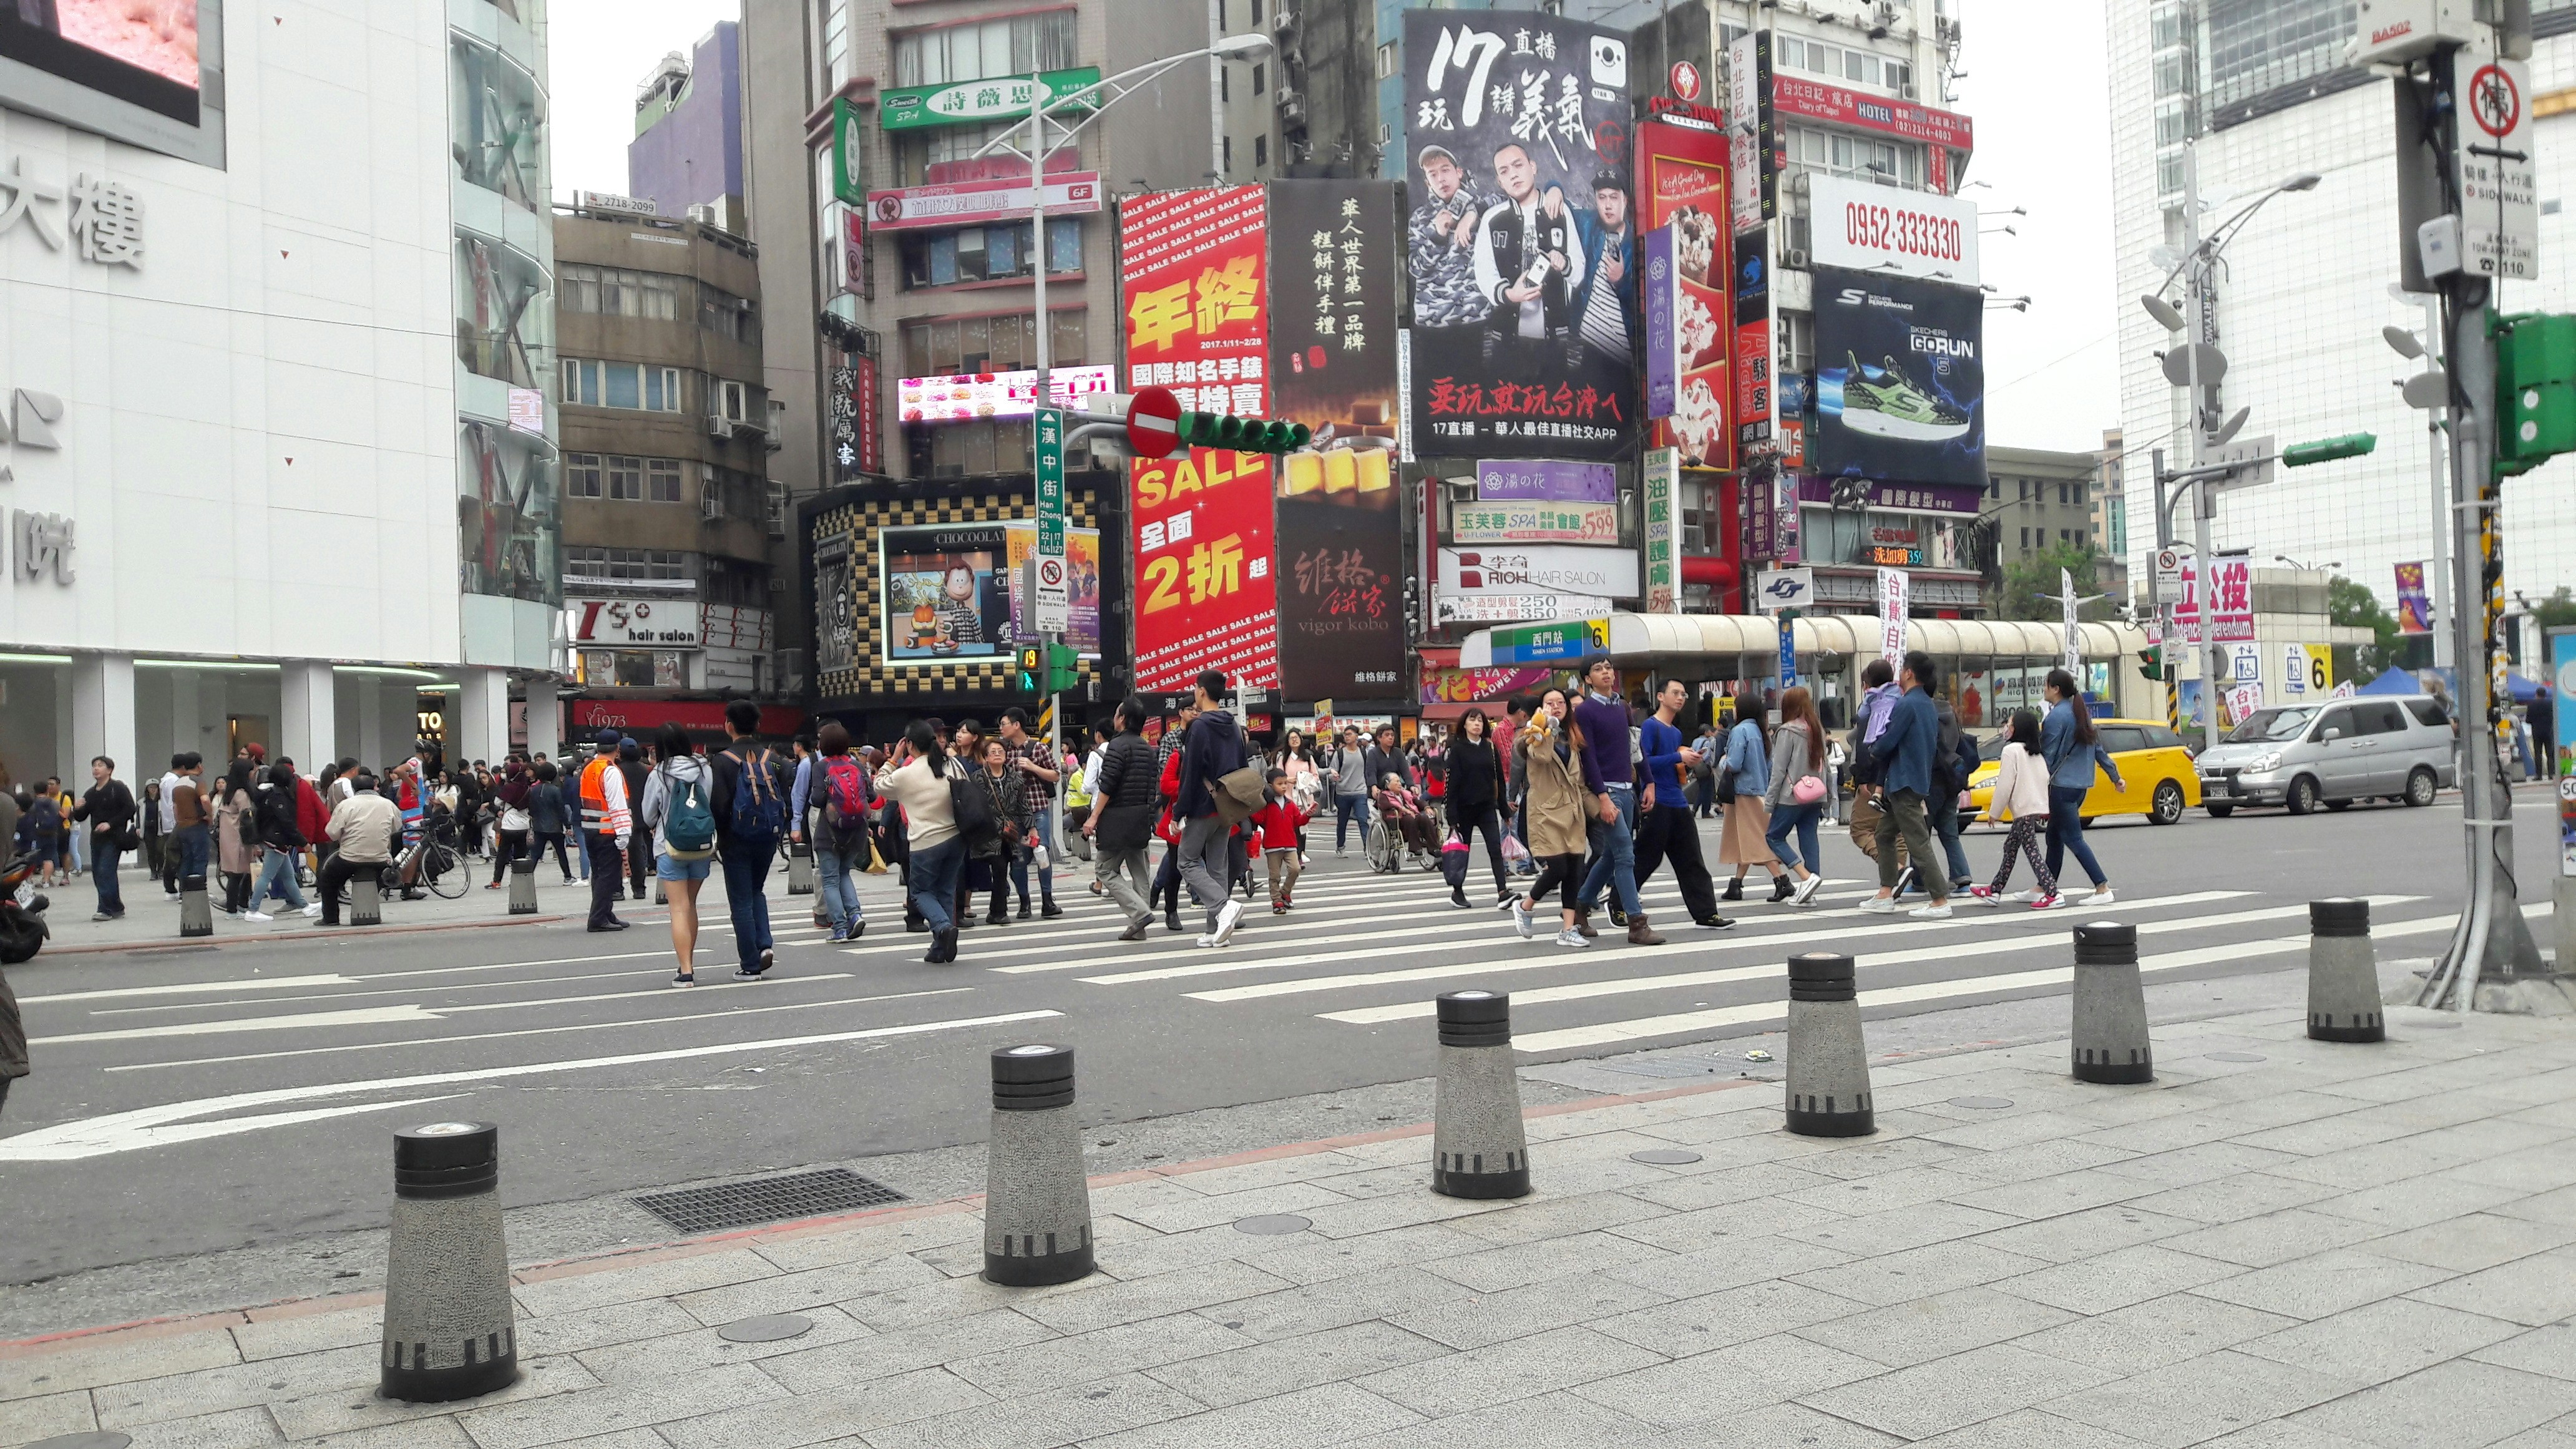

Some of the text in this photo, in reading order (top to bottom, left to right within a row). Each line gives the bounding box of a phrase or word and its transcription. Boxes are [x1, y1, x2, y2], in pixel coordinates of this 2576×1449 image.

[1511, 26, 1558, 61] 直播
[1427, 23, 1507, 127] 17
[1418, 97, 1455, 131] 玩
[1857, 102, 1891, 122] HOTEL
[1072, 189, 1089, 200] 6F
[2479, 190, 2534, 205] SIDWALK
[604, 197, 655, 212] 2718-2099
[1122, 195, 1167, 219] SALE SALE
[1123, 191, 1216, 235] SALE SALE SALE SALE
[1123, 188, 1264, 250] SALE SALE SALE SALE SALE SALE
[1493, 230, 1508, 248] 17
[1340, 197, 1367, 352] 華人世界第一品牌
[2502, 261, 2524, 275] 110
[1128, 254, 1261, 353] 年終
[1652, 285, 1665, 350] 湯の花
[1910, 325, 1948, 336] SKECHERS
[1131, 356, 1262, 388] 國際知名手錶
[1936, 356, 1951, 374] 5
[1433, 421, 1617, 440] 17直播 華人最佳直播社交APP
[1042, 427, 1058, 497] 漢中街
[1137, 449, 1265, 509] SALE
[1505, 472, 1546, 490] 湯の花
[1040, 500, 1054, 509] Han
[1040, 510, 1061, 521] Zhong
[1460, 512, 1506, 530] 玉芙蓉
[1509, 513, 1536, 529] SPA
[1140, 509, 1193, 553] 全面
[1649, 523, 1668, 539] SPA
[1041, 545, 1050, 553] 116
[1053, 545, 1063, 554] 127
[1249, 556, 1267, 580] 起
[1488, 570, 1606, 585] RIOH HAIR SALON
[1520, 596, 1558, 608] 250
[1520, 607, 1558, 620] 350
[628, 628, 694, 642] hair salon
[1298, 617, 1389, 636] vigor kobo
[1135, 608, 1276, 664] SALE SALE SALE SALE SALE SALE
[1532, 630, 1564, 646] 西門站
[1592, 627, 1603, 648] 6
[1025, 650, 1035, 666] 19
[1136, 624, 1276, 680] SALE SALE SALE SALE SALE SALE
[1136, 640, 1277, 692] SALE SALE SALE SALE SALE SALE
[1231, 656, 1277, 678] SALE SALE
[1473, 666, 1501, 678] EYA
[2312, 657, 2325, 690] 6
[1256, 671, 1278, 685] SALE
[1354, 670, 1398, 683] 維格餅家
[1472, 667, 1518, 701] FLOWER
[417, 712, 441, 729] TO
